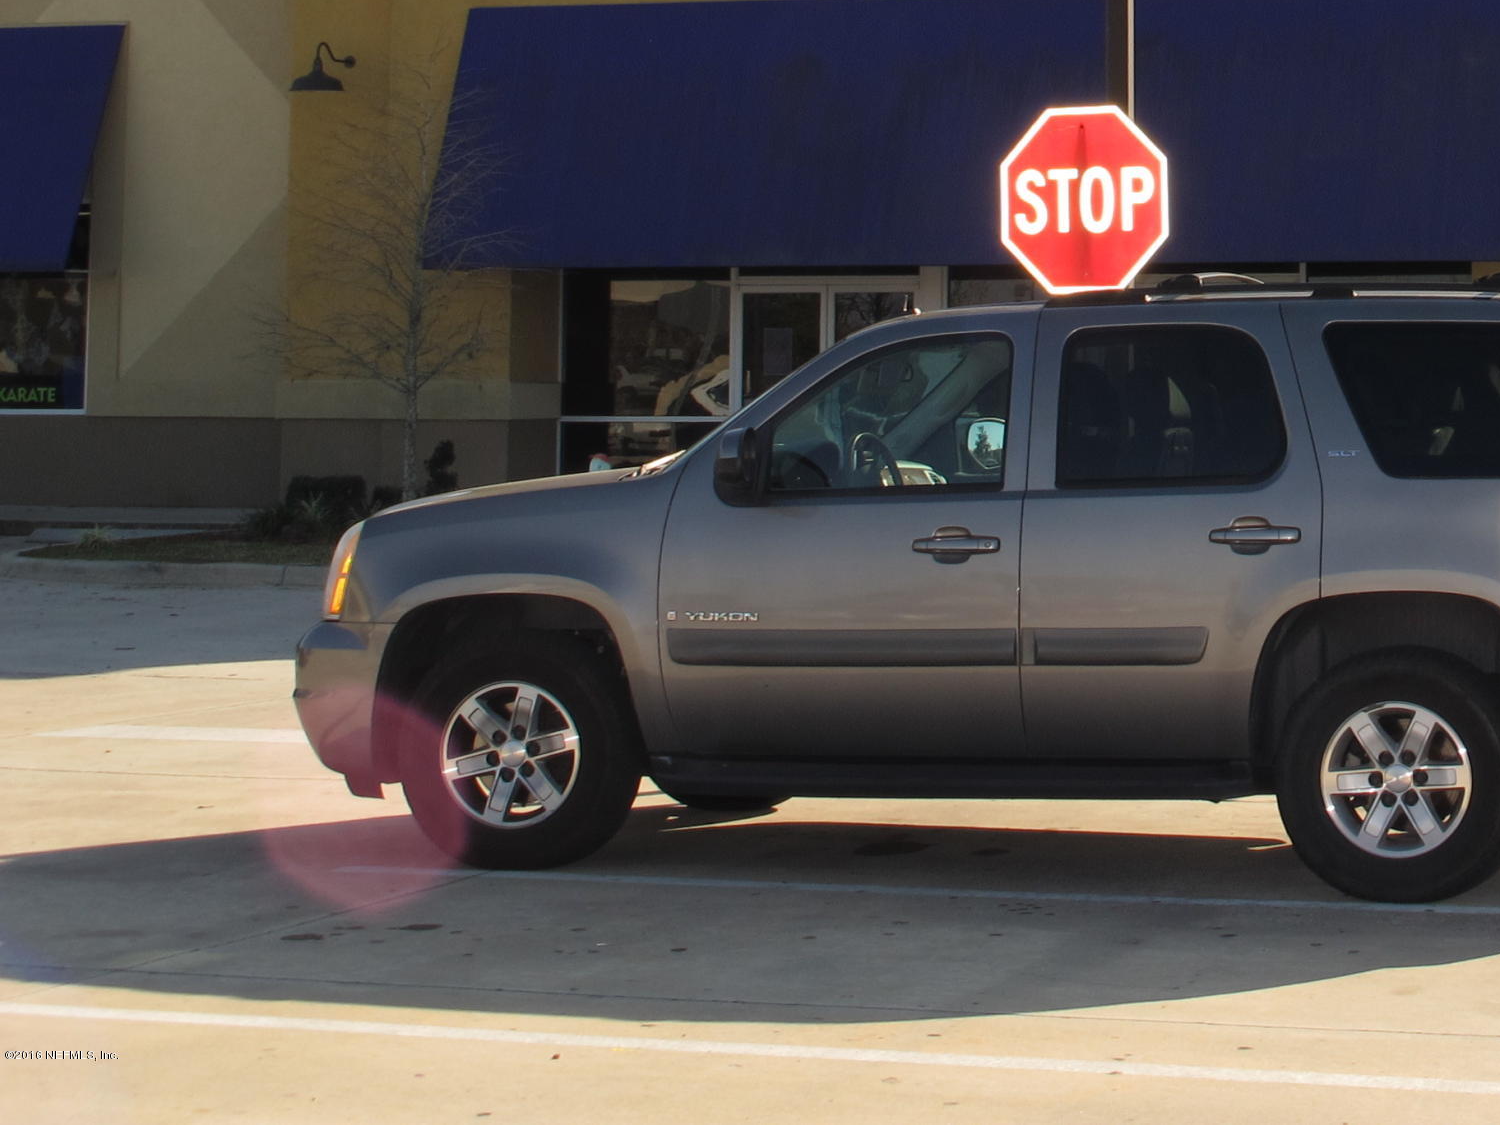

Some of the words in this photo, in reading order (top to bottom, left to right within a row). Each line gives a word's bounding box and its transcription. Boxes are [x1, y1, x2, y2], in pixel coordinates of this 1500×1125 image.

[1014, 166, 1155, 235] STOP
[0, 387, 56, 402] KARATE
[685, 612, 758, 621] YUKON
